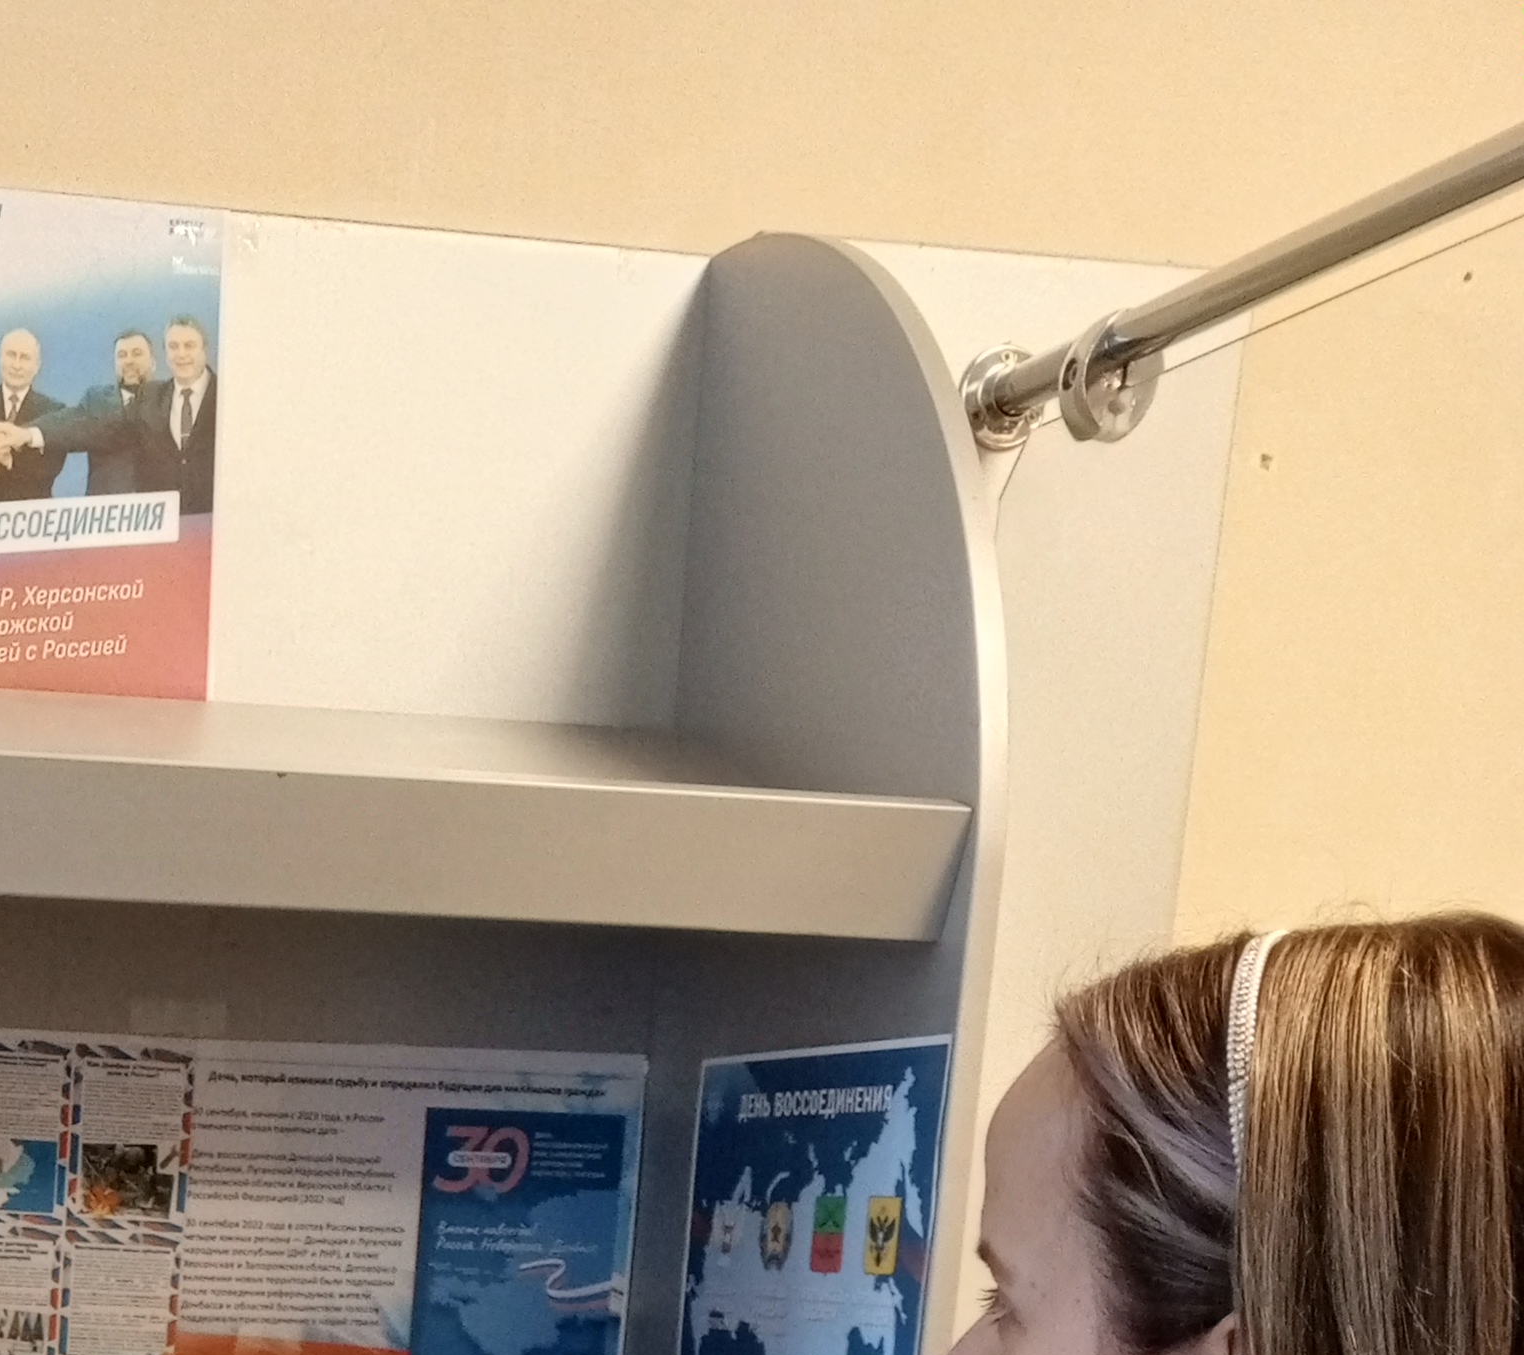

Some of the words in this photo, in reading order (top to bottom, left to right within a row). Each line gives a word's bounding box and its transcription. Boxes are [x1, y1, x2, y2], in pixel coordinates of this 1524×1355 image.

[22, 579, 144, 608] Херсонской
[25, 644, 39, 662] с
[42, 631, 127, 661] Россией
[737, 1091, 771, 1122] ДЕНЬ
[774, 1084, 894, 1120] ВОССОЕДИНЕНИЯ
[433, 1125, 530, 1194] 30
